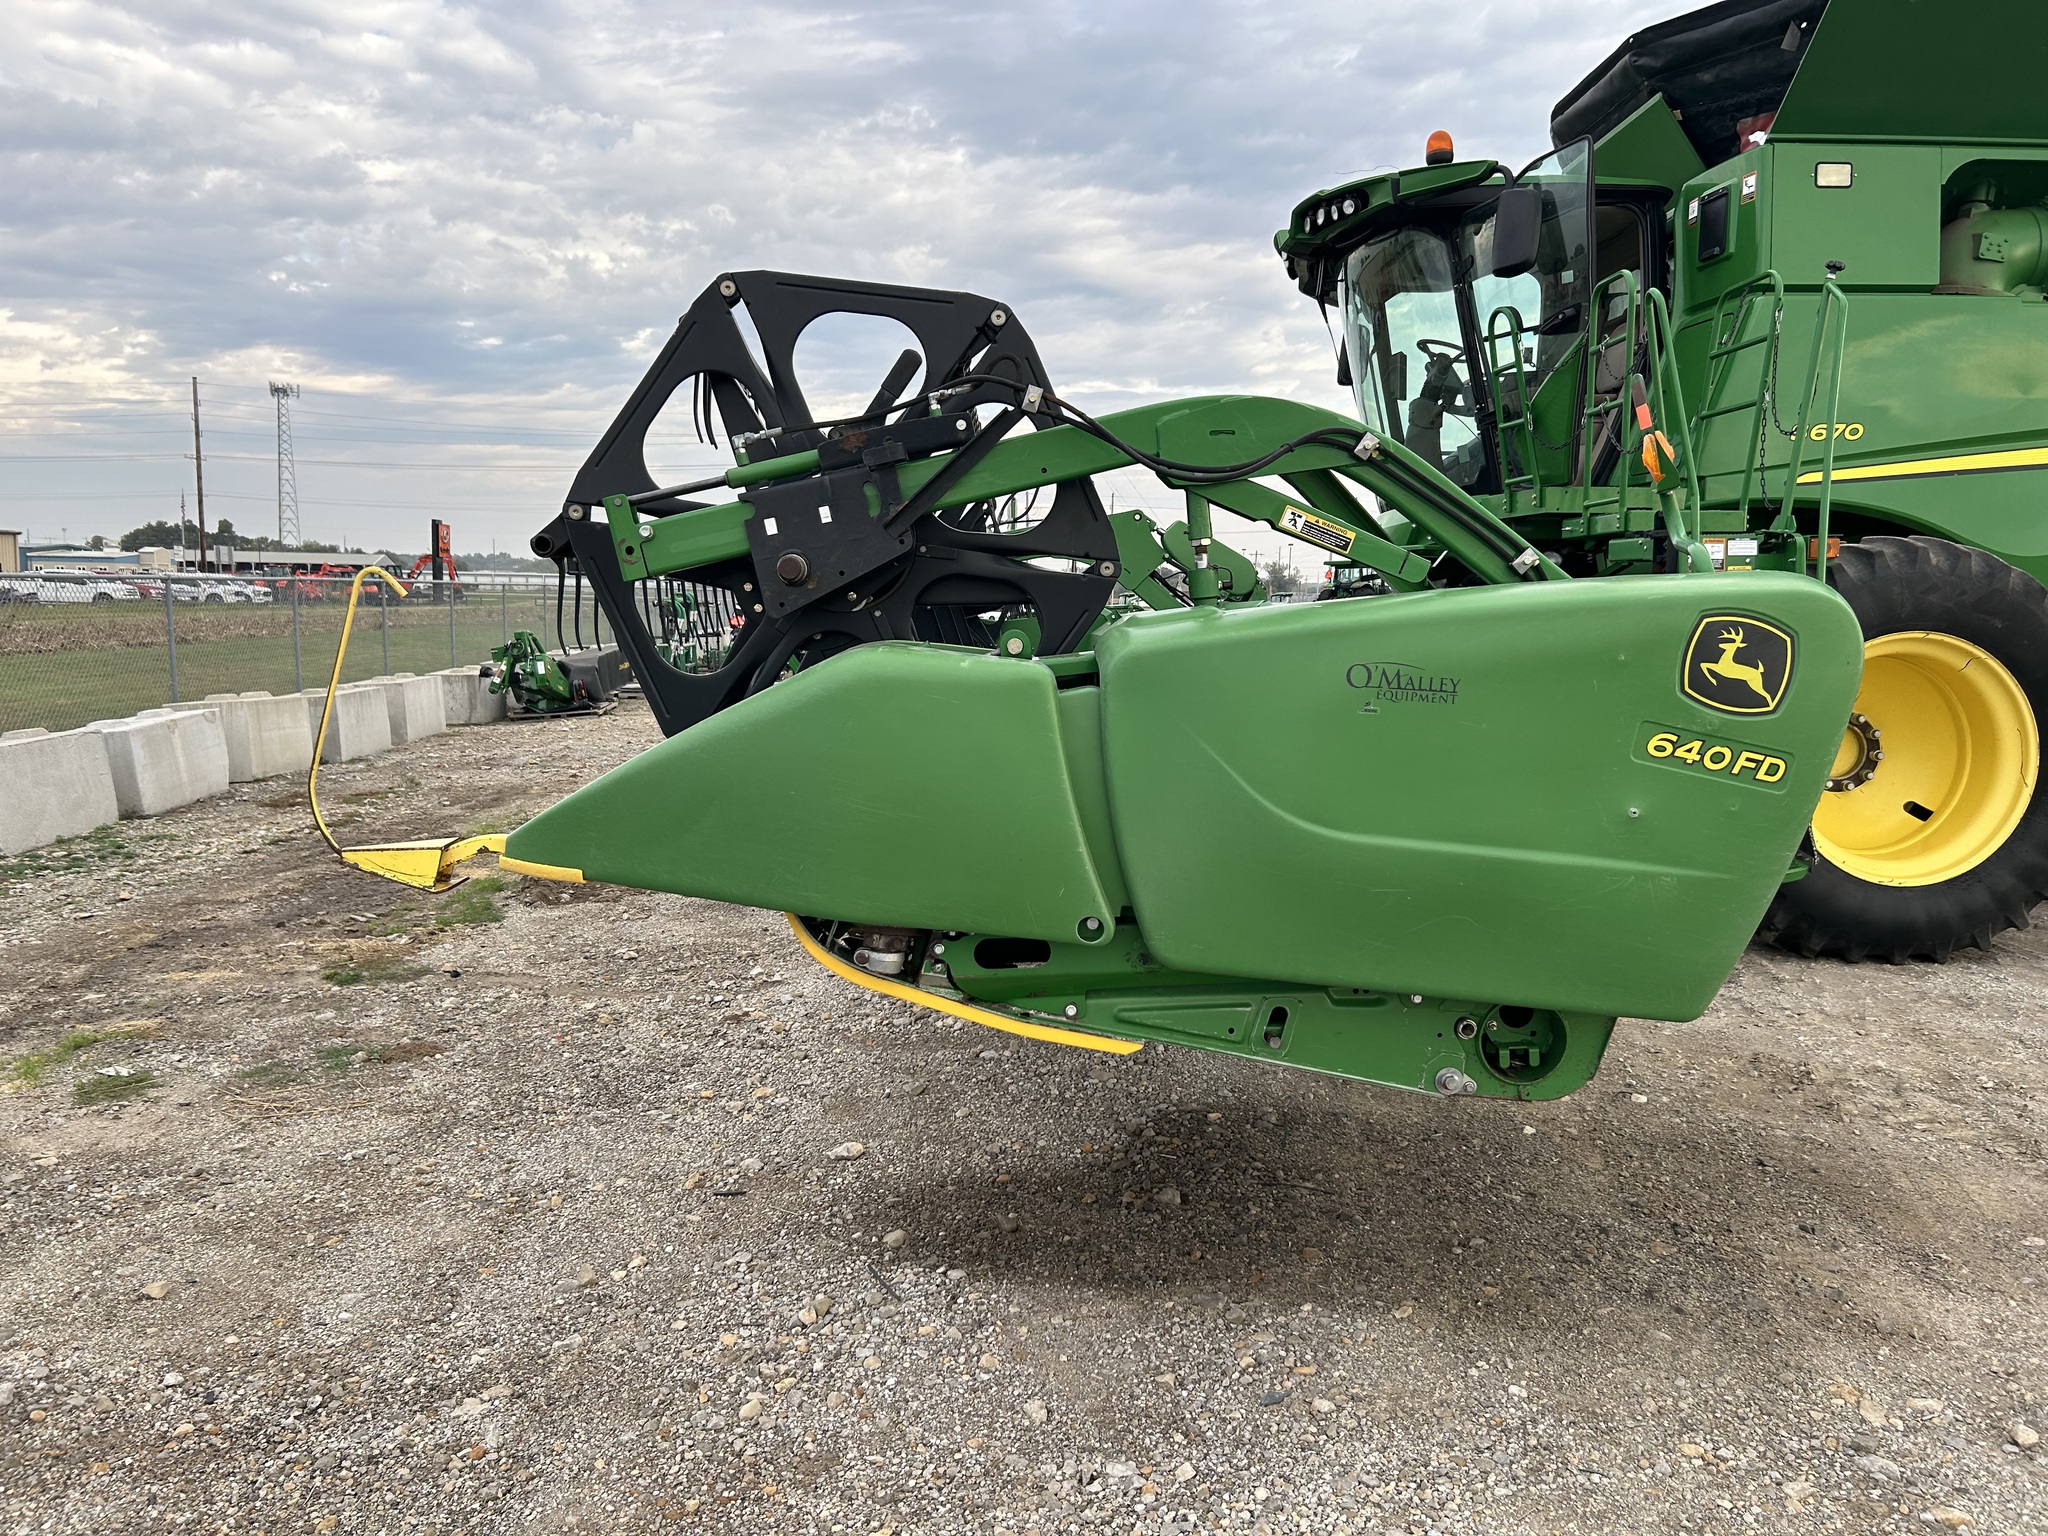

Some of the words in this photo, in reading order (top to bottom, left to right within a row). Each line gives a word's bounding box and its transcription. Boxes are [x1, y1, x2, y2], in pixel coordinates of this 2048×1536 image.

[1321, 521, 1348, 535] WARNING
[1346, 662, 1461, 693] O'MALLEY
[1376, 689, 1459, 704] EQUIPMENT
[1646, 732, 1787, 783] 640FD
